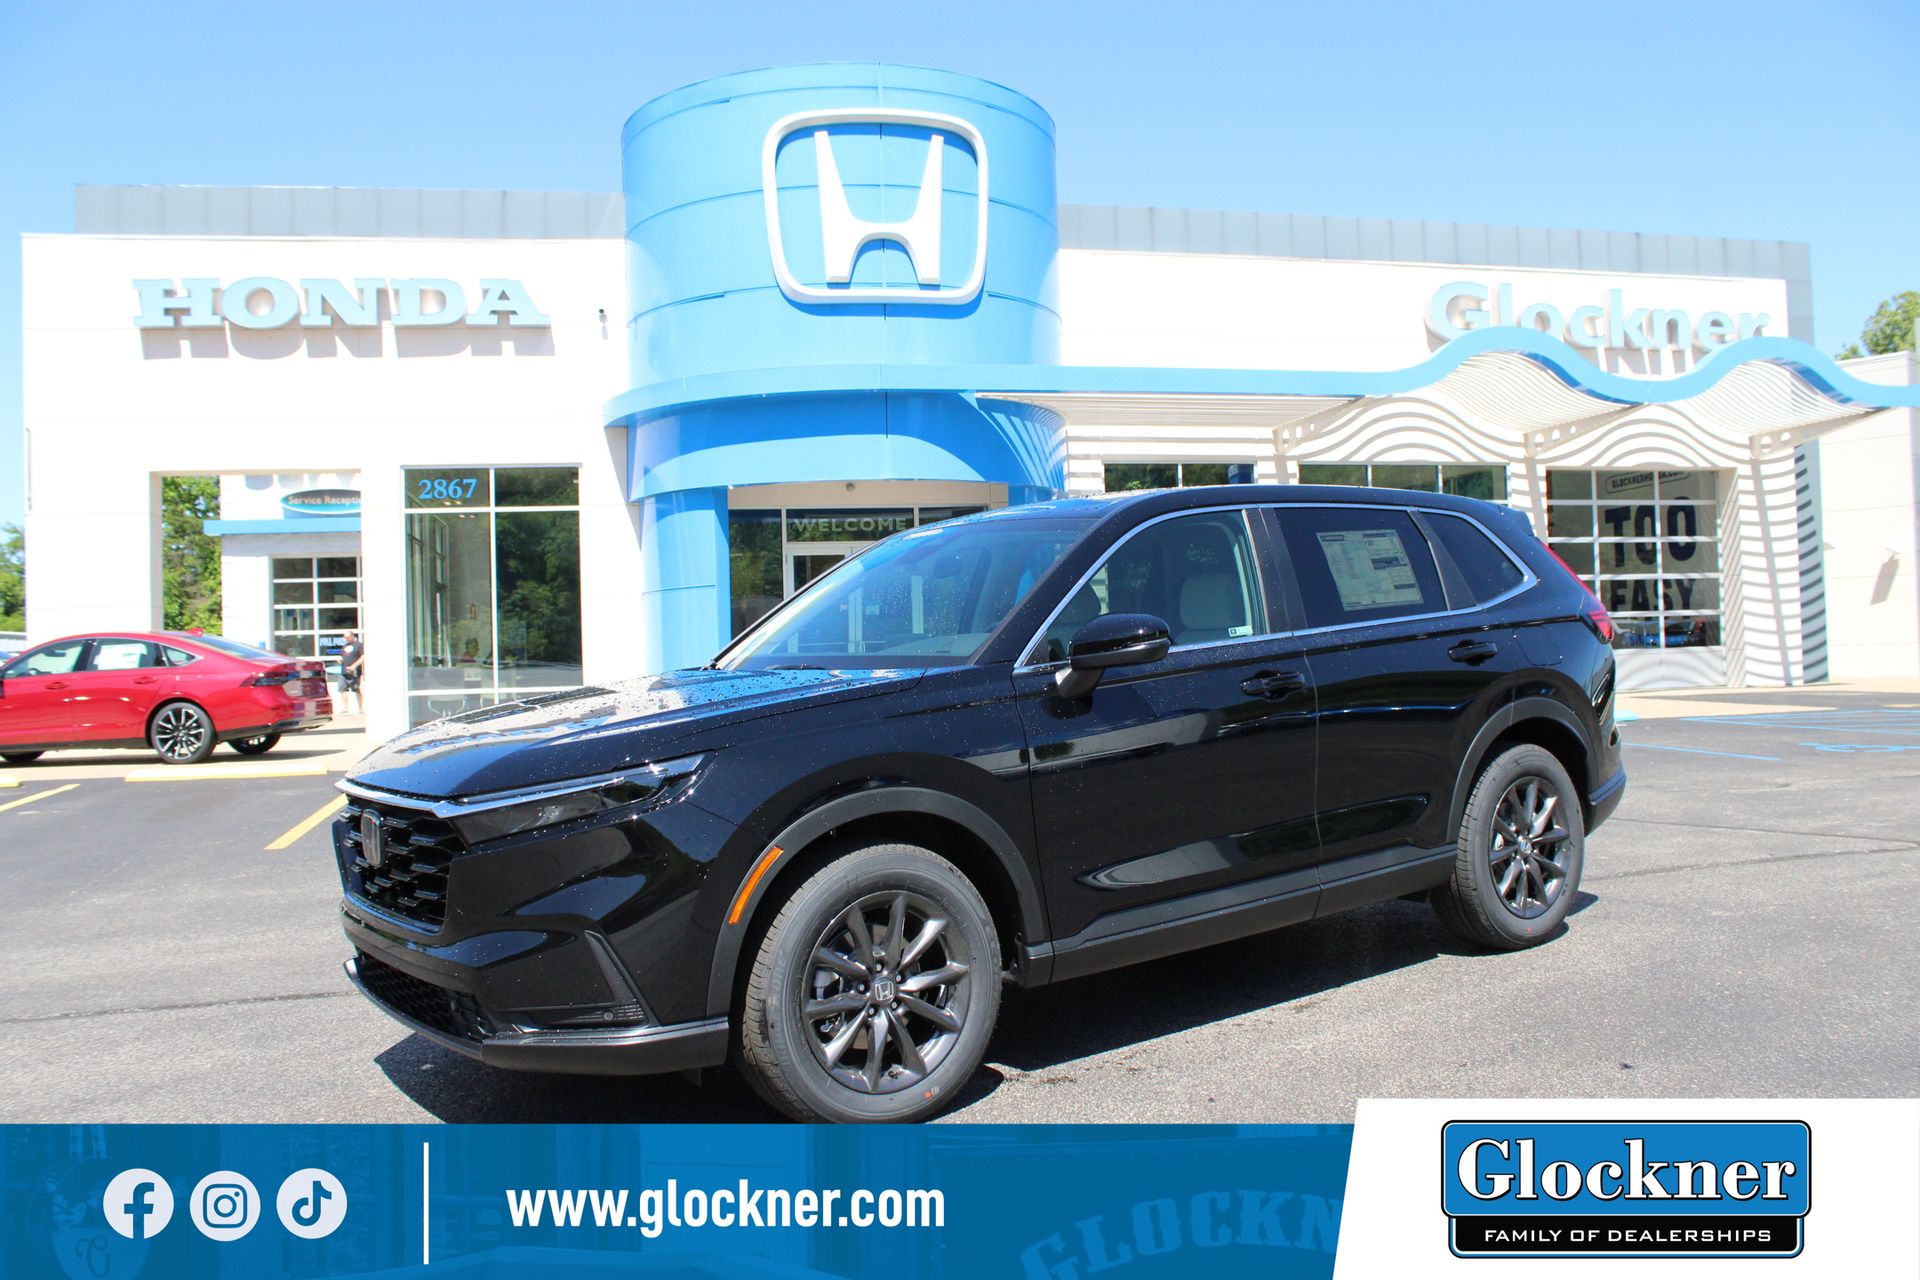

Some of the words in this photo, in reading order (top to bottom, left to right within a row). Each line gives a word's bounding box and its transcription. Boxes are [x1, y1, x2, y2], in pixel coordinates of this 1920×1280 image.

[132, 277, 551, 329] HONDA
[1427, 281, 1771, 350] Glockner
[288, 495, 322, 505] Service
[418, 478, 478, 499] 2867
[794, 517, 906, 533] WELCOME
[1605, 496, 1697, 567] TOO
[1610, 578, 1697, 620] EASY
